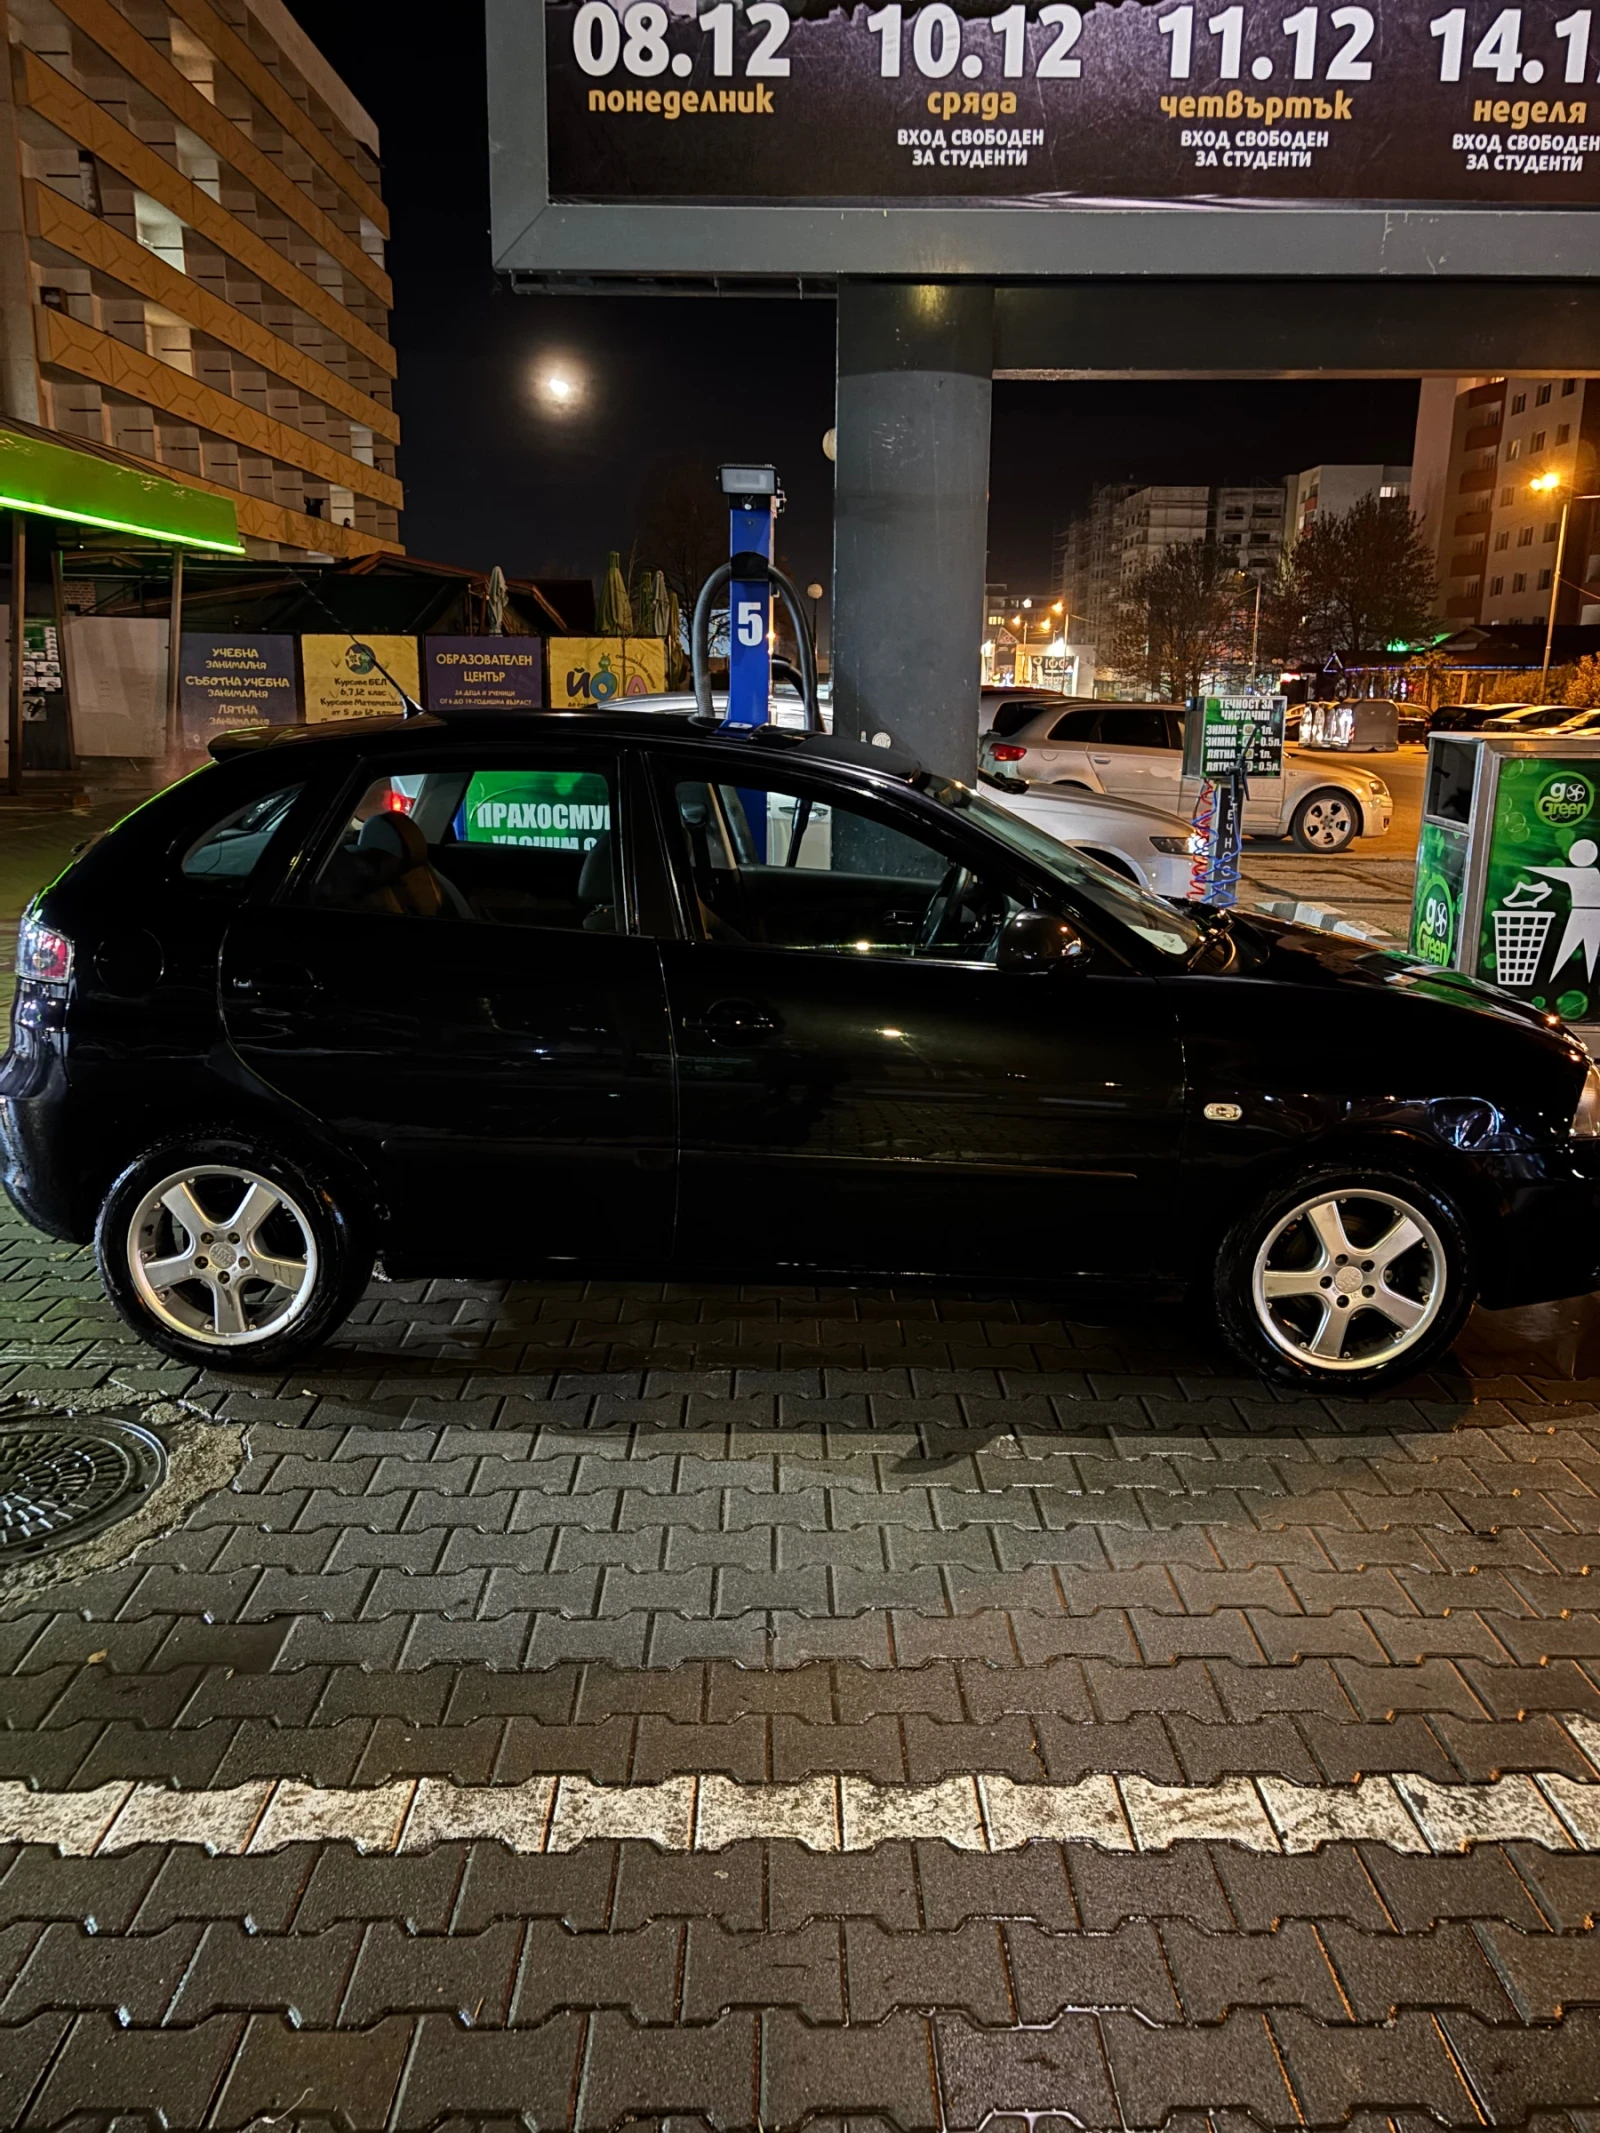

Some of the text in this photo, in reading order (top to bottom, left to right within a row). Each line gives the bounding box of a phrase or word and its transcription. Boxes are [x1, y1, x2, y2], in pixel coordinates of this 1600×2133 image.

[573, 2, 790, 77] 08.12
[867, 3, 1082, 78] 10.12
[1158, 5, 1374, 80] 11.12
[1430, 8, 1600, 84] 14.1
[589, 83, 774, 119] понеделник
[927, 91, 1017, 120] сряда
[1160, 90, 1353, 124] четвъртък
[1473, 97, 1588, 129] неделя
[897, 129, 1044, 149] ВХОД СВОБОДЕН
[1181, 130, 1329, 151] ВХОД СВОБОДЕН
[1452, 133, 1600, 154] ВХОД СВОБОДЕН
[912, 149, 1028, 168] ЗА СТУДЕНТИ
[1195, 151, 1312, 170] ЗА СТУДЕНТИ
[1465, 153, 1584, 173] ЗА СТУДЕНТИ
[737, 602, 764, 647] 5
[212, 648, 258, 658] УЧЕБНА
[205, 660, 267, 670] ЗАНИМАЛНЯ
[436, 654, 533, 666] ОБРАЗОВАТЕЛЕН
[185, 676, 290, 688] СЪБОТНА УЧЕБНА
[334, 678, 388, 686] Курсове БЕЛ
[463, 671, 506, 683] ЦЕНТЪР
[208, 689, 269, 699] ЗАНИМАЛНЯ
[320, 698, 353, 707] Курсове
[1219, 699, 1274, 710] ТЕЧНОСТ ЗА
[218, 704, 258, 715] ЛЯТНА
[365, 708, 374, 716] 12
[1221, 710, 1270, 721] ЧИСТАЧКИ
[1206, 724, 1238, 735] ЗИМНА
[1261, 725, 1274, 735] 1л.
[1205, 736, 1237, 747] ЗИМНА
[1260, 737, 1282, 747] 0.5л.
[1206, 749, 1236, 759] ЛЯТНА
[1259, 749, 1272, 759] 1л.
[1258, 761, 1280, 772] 0.5л.
